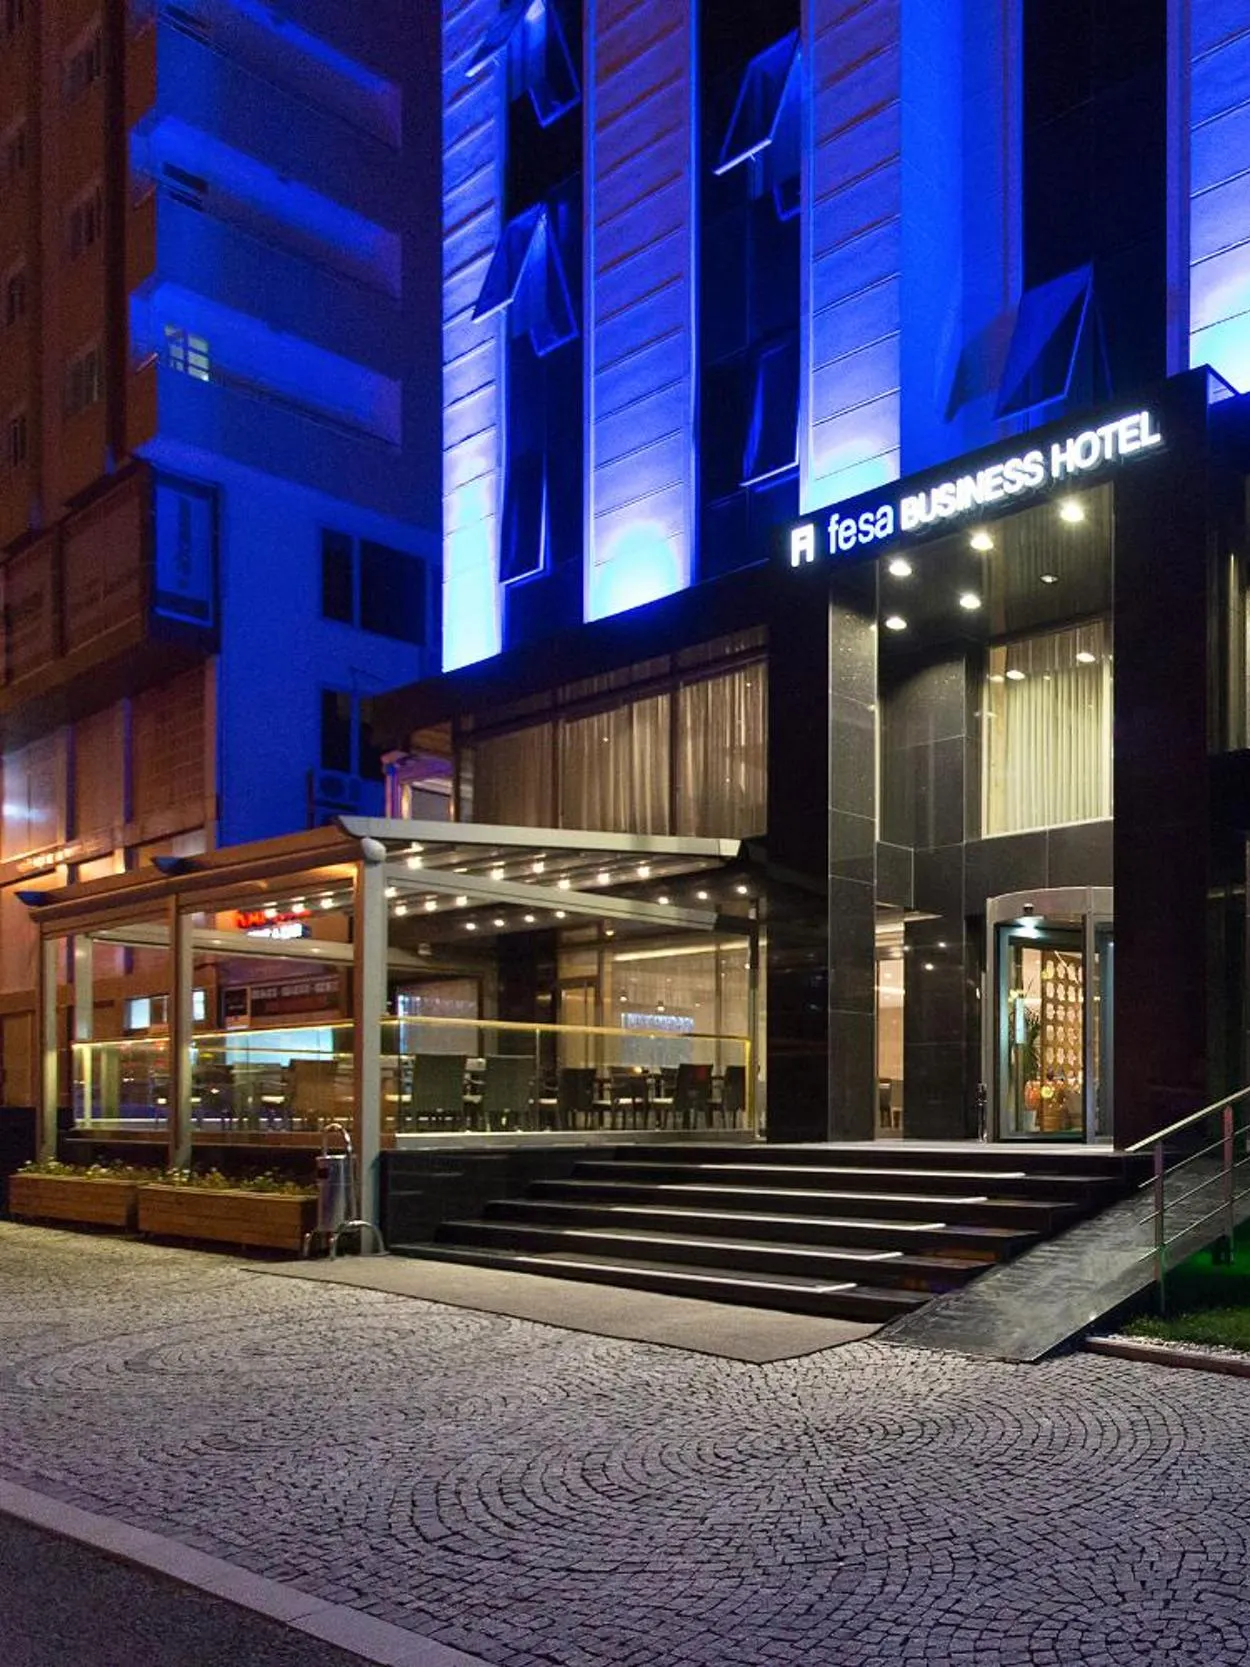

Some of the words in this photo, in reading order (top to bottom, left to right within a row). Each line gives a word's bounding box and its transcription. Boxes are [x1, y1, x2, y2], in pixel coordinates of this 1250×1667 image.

[828, 505, 895, 554] fesa
[901, 450, 1044, 531] BUSINESS
[1051, 411, 1161, 477] HOTEL
